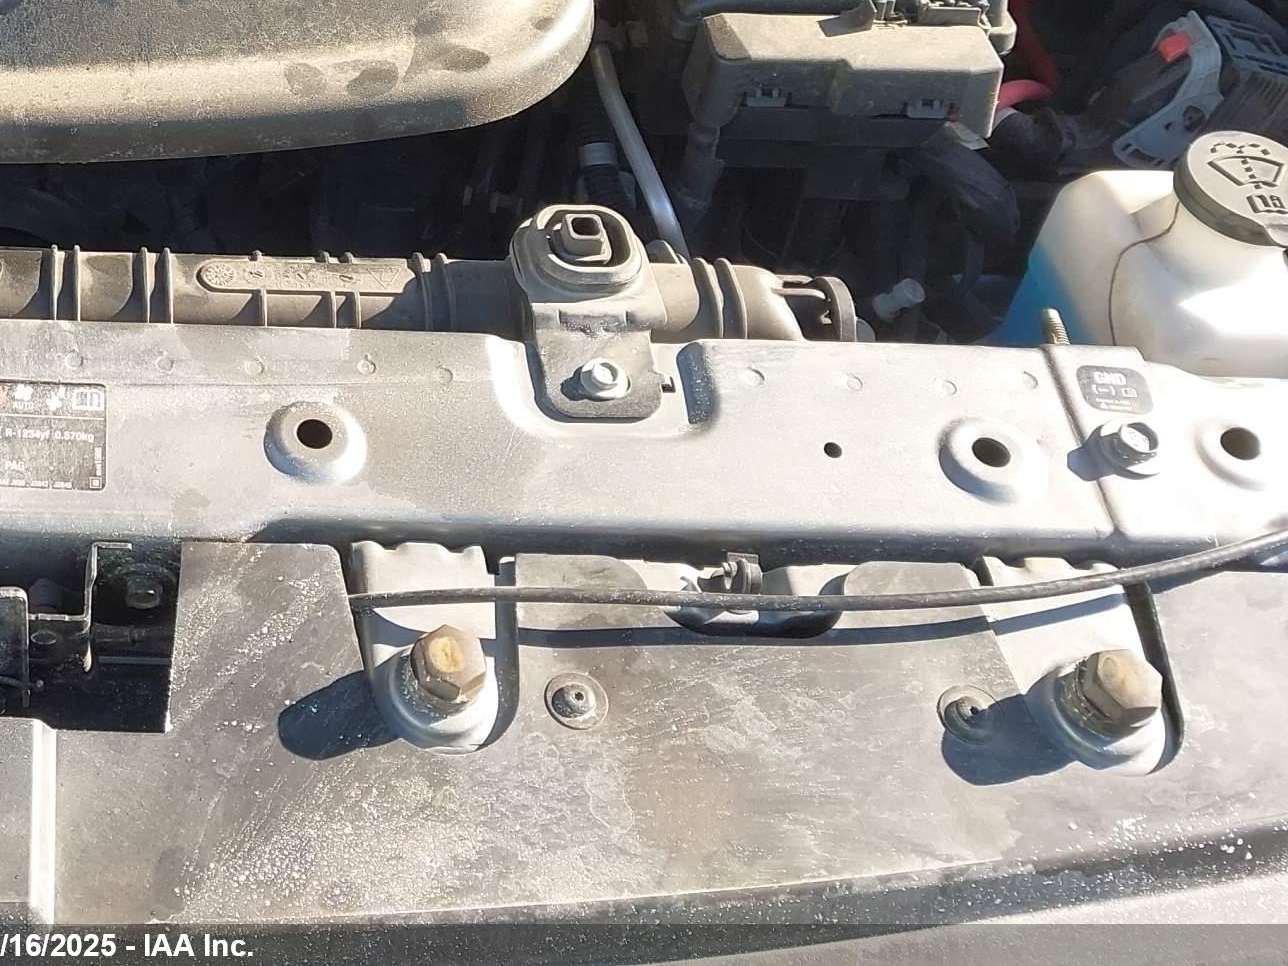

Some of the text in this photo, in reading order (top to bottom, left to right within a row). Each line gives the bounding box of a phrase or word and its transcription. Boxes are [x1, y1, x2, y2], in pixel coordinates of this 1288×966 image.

[1093, 371, 1127, 385] GND
[12, 401, 34, 410] AUTO
[5, 428, 95, 443] R-1234yf 0.570kg
[5, 461, 24, 471] PAG
